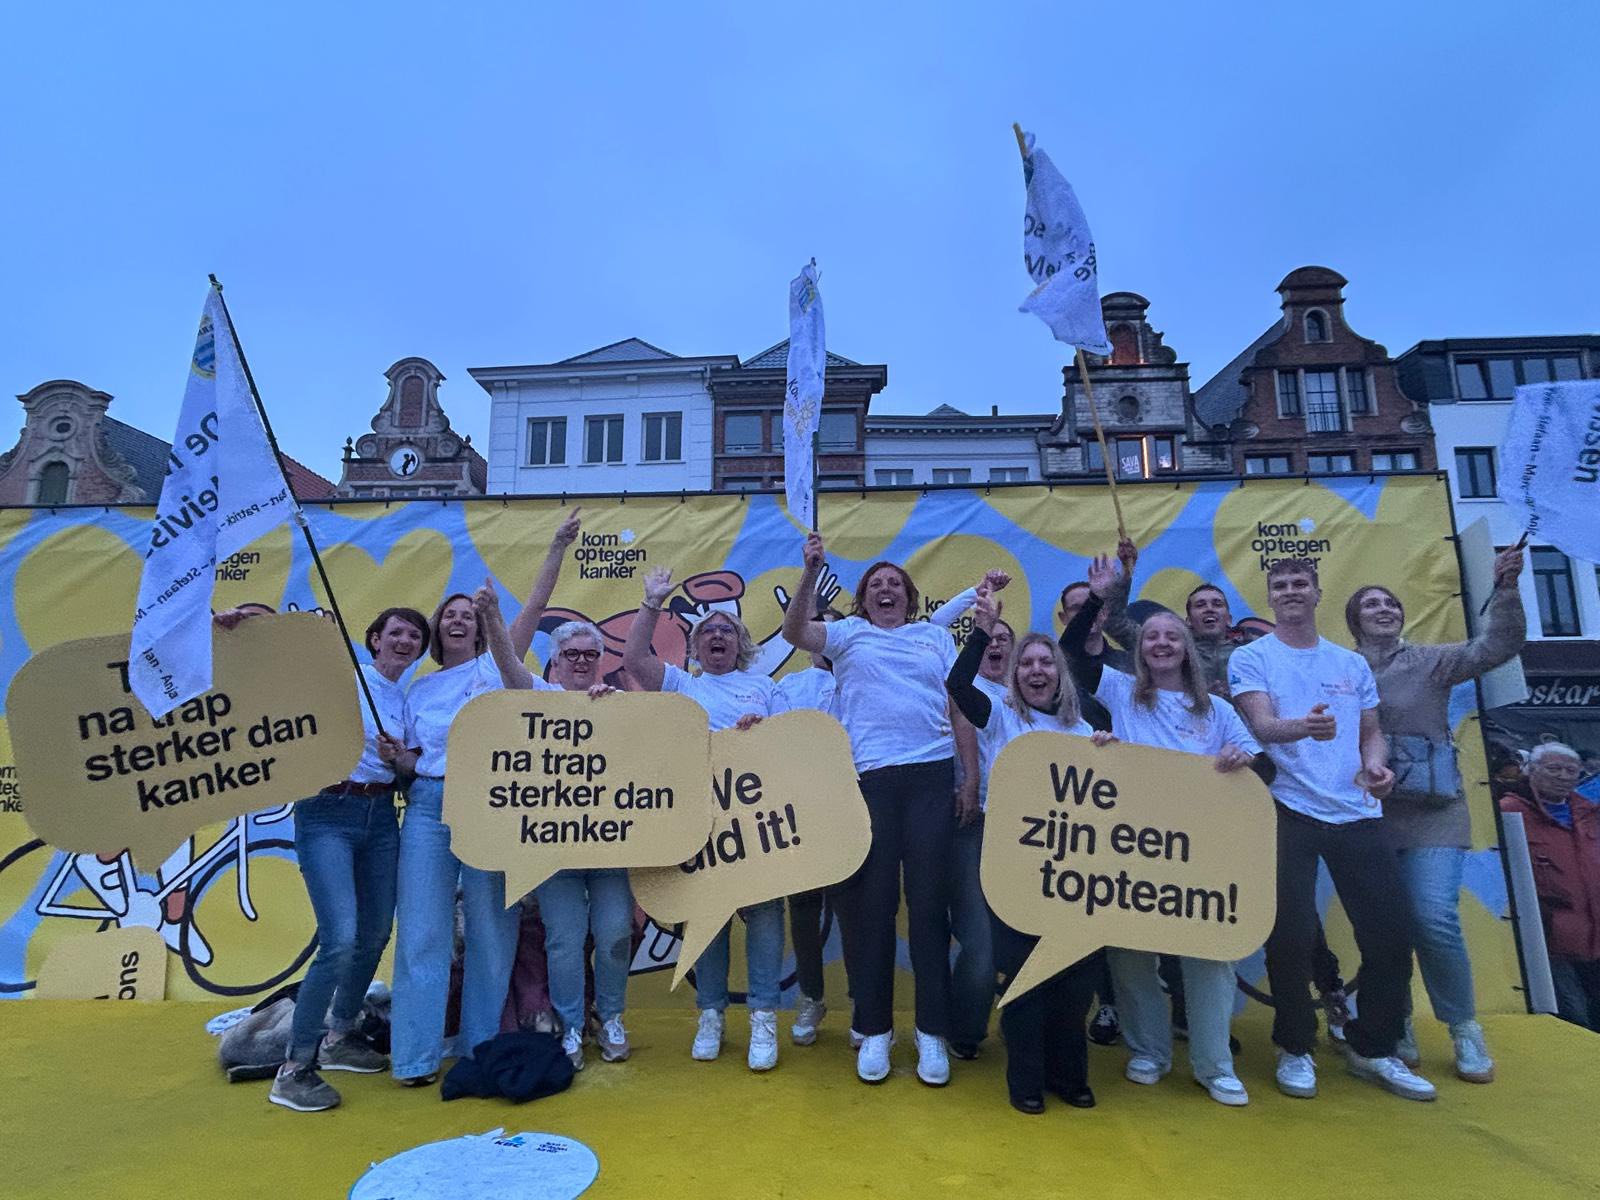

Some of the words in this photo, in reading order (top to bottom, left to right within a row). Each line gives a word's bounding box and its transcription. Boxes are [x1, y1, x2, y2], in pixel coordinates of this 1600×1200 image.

[582, 531, 618, 546] kom
[1258, 521, 1298, 537] kom
[215, 566, 250, 580] nker
[580, 563, 636, 579] kanker
[79, 707, 135, 740] na
[521, 713, 593, 746] Trap
[85, 726, 236, 782] sterker
[248, 714, 317, 748] dan
[492, 750, 531, 773] na
[542, 748, 607, 781] trap
[137, 757, 276, 812] kanker
[489, 780, 606, 808] sterker
[614, 782, 673, 809] dan
[1050, 763, 1118, 810] We
[521, 814, 633, 844] kanker
[755, 803, 801, 853] it!
[1019, 810, 1096, 861] zijn
[1110, 823, 1190, 862] een
[1040, 859, 1238, 924] topteam!
